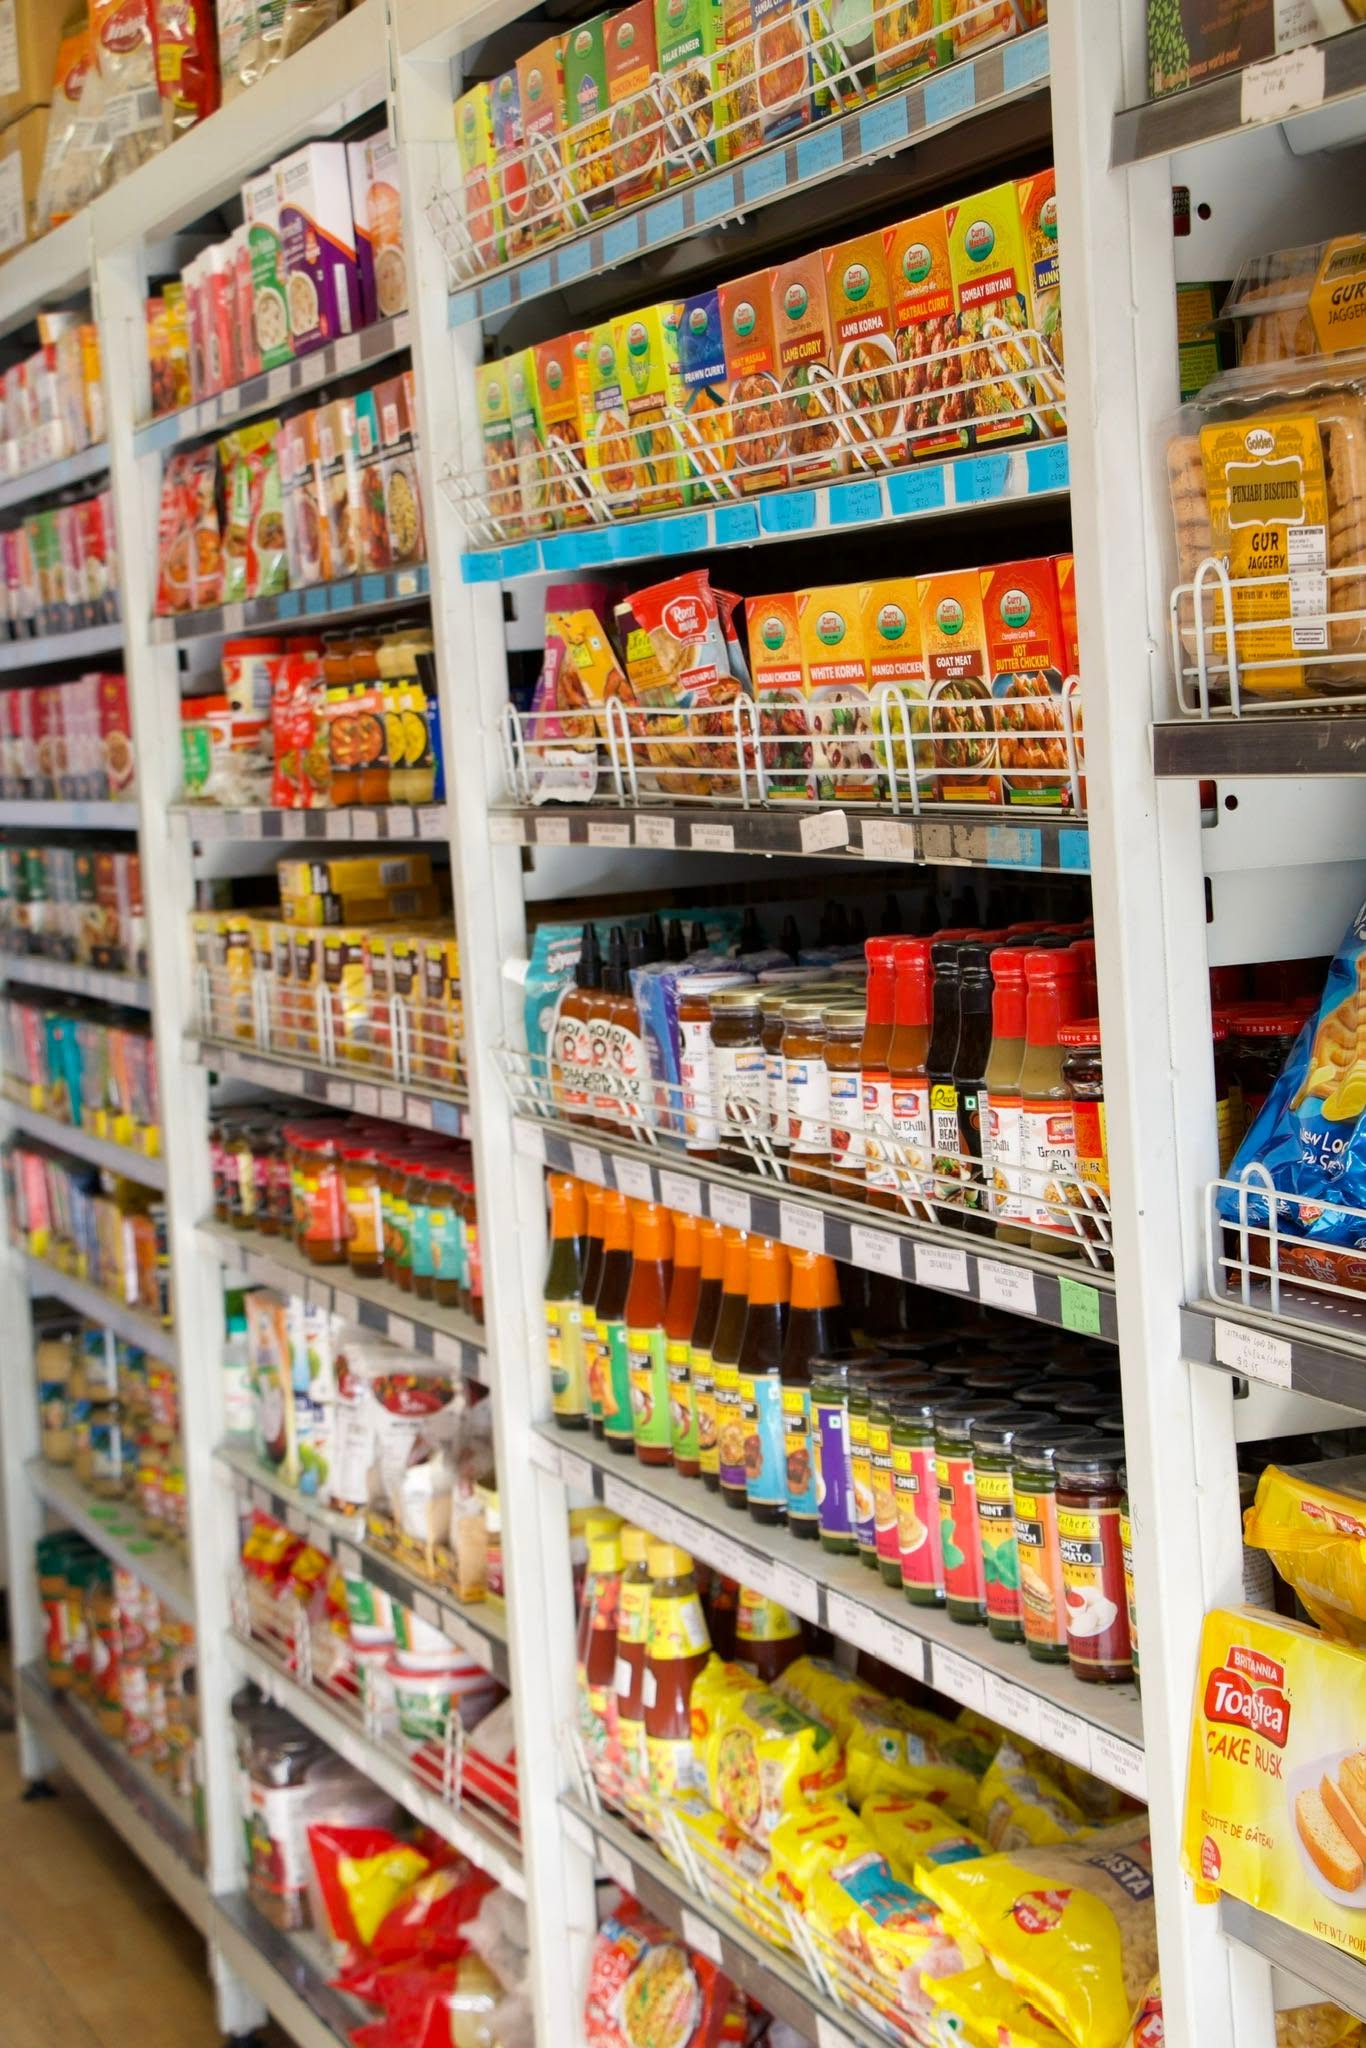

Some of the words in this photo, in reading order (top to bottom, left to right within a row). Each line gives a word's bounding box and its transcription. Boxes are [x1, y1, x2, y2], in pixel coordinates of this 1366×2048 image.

[678, 37, 700, 56] PANEER
[970, 227, 986, 239] Curry
[908, 249, 923, 261] Curry
[961, 284, 985, 304] BOMBAY
[985, 276, 1012, 296] BIRYANI
[898, 302, 928, 322] MEATBALL
[928, 295, 949, 313] CURRY
[841, 321, 859, 338] LAMB
[858, 315, 884, 334] KORMA
[782, 347, 799, 363] LAMB
[799, 339, 822, 357] CURRY
[684, 368, 705, 385] PRAWN
[704, 363, 726, 379] CURRY
[1246, 433, 1274, 451] Golden
[1232, 483, 1262, 504] PUNJABI
[1264, 480, 1299, 501] BISCUITS
[1251, 532, 1279, 552] GUR
[1247, 554, 1286, 570] JAGGERY
[942, 603, 956, 615] Curry
[1006, 595, 1022, 607] Curry
[883, 610, 898, 621] Curry
[1012, 644, 1027, 657] HOT
[871, 664, 895, 676] MANGO
[895, 661, 924, 674] CHICKEN
[936, 656, 954, 668] GOAT
[953, 654, 973, 667] MEAT
[995, 657, 1020, 672] BUTTER
[1019, 654, 1050, 670] CHICKEN
[774, 670, 801, 683] CHICKEN
[810, 666, 834, 681] WHITE
[834, 663, 865, 678] KORMA
[946, 666, 964, 677] CURRY
[1037, 1145, 1071, 1160] Green
[979, 1503, 1004, 1517] MINT
[1234, 1651, 1278, 1682] BRITANNIA
[1215, 1682, 1283, 1733] Toastea
[1206, 1731, 1251, 1766] CAKE
[1255, 1745, 1283, 1779] RUSK
[1230, 1825, 1243, 1839] DE
[1245, 1823, 1274, 1849] GÂTEAU
[1312, 1917, 1328, 1936] NET
[1329, 1925, 1342, 1942] WT
